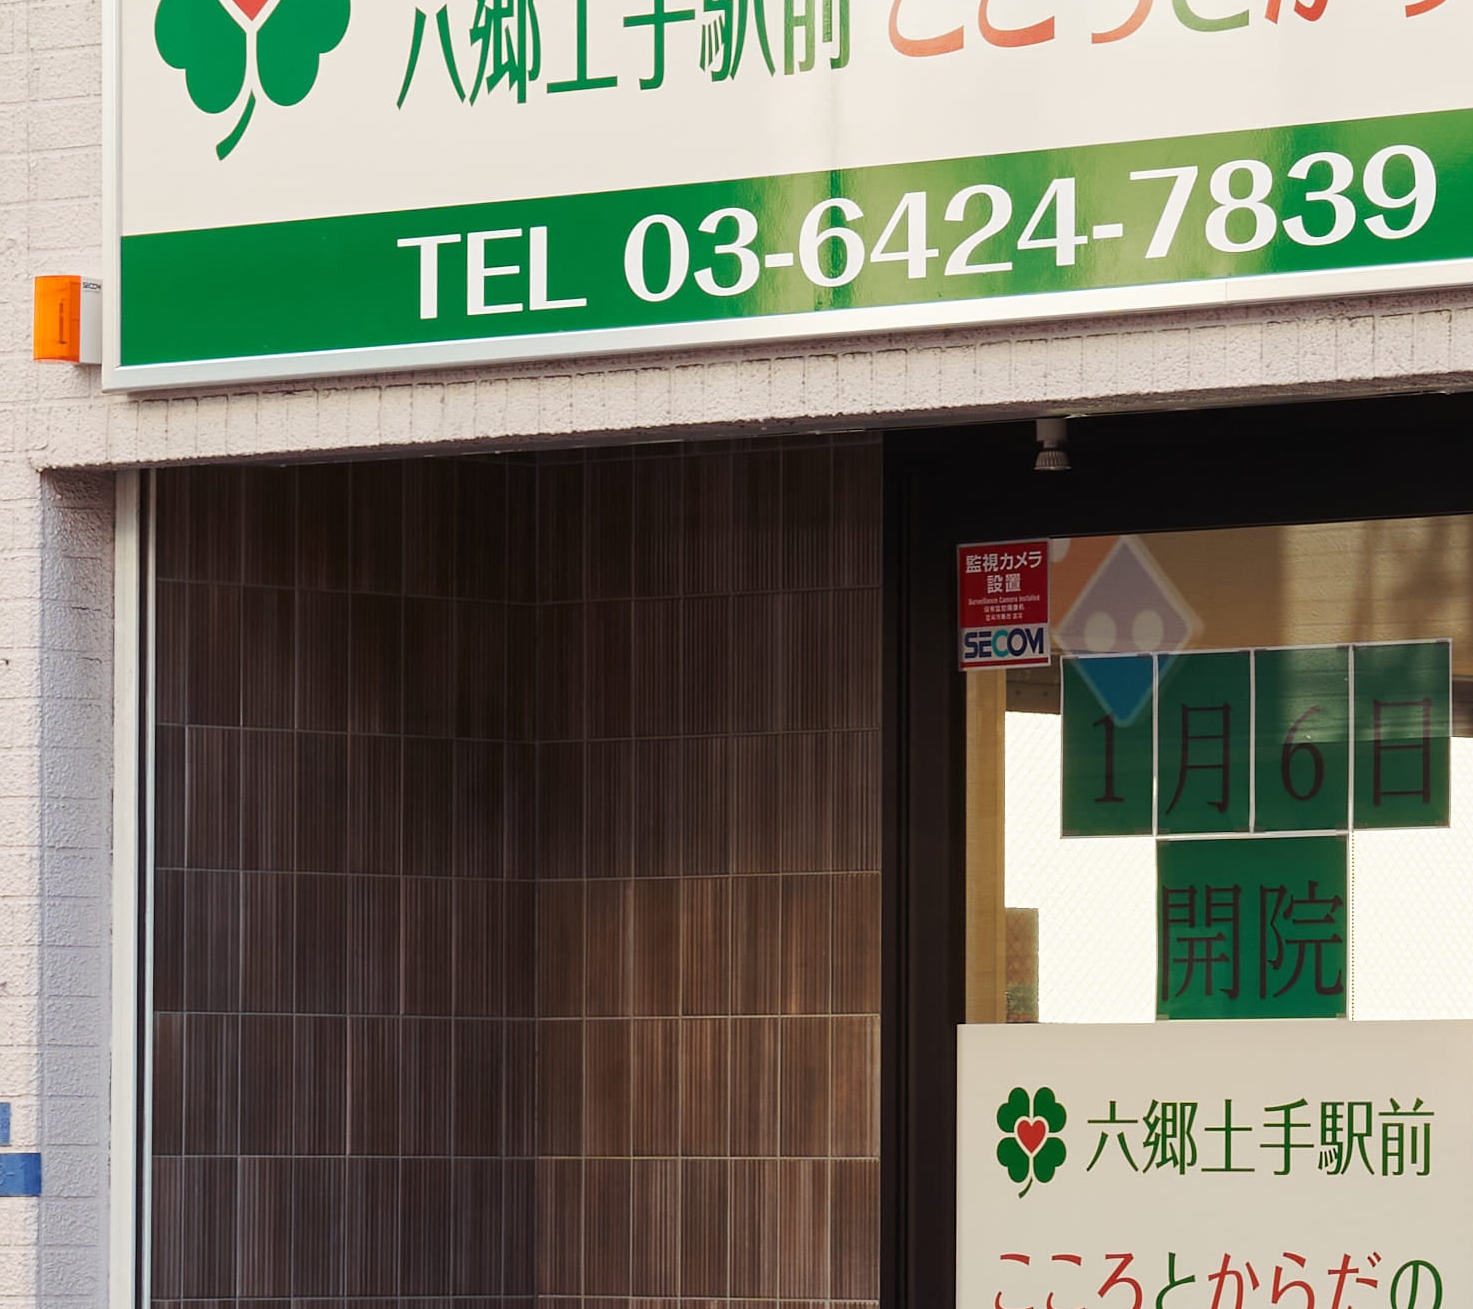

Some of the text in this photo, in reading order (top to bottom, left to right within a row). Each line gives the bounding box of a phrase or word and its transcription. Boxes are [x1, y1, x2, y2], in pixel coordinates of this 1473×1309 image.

[397, 228, 589, 321] TEL
[623, 144, 1438, 304] 03-6424-7839
[965, 551, 1042, 573] 監視カメラ
[987, 573, 1021, 594] 設置
[964, 627, 1044, 659] SECOM
[1090, 698, 1434, 816] 1月6日
[1161, 880, 1345, 1002] 開院
[1086, 1097, 1435, 1177] 六郷土手駅前
